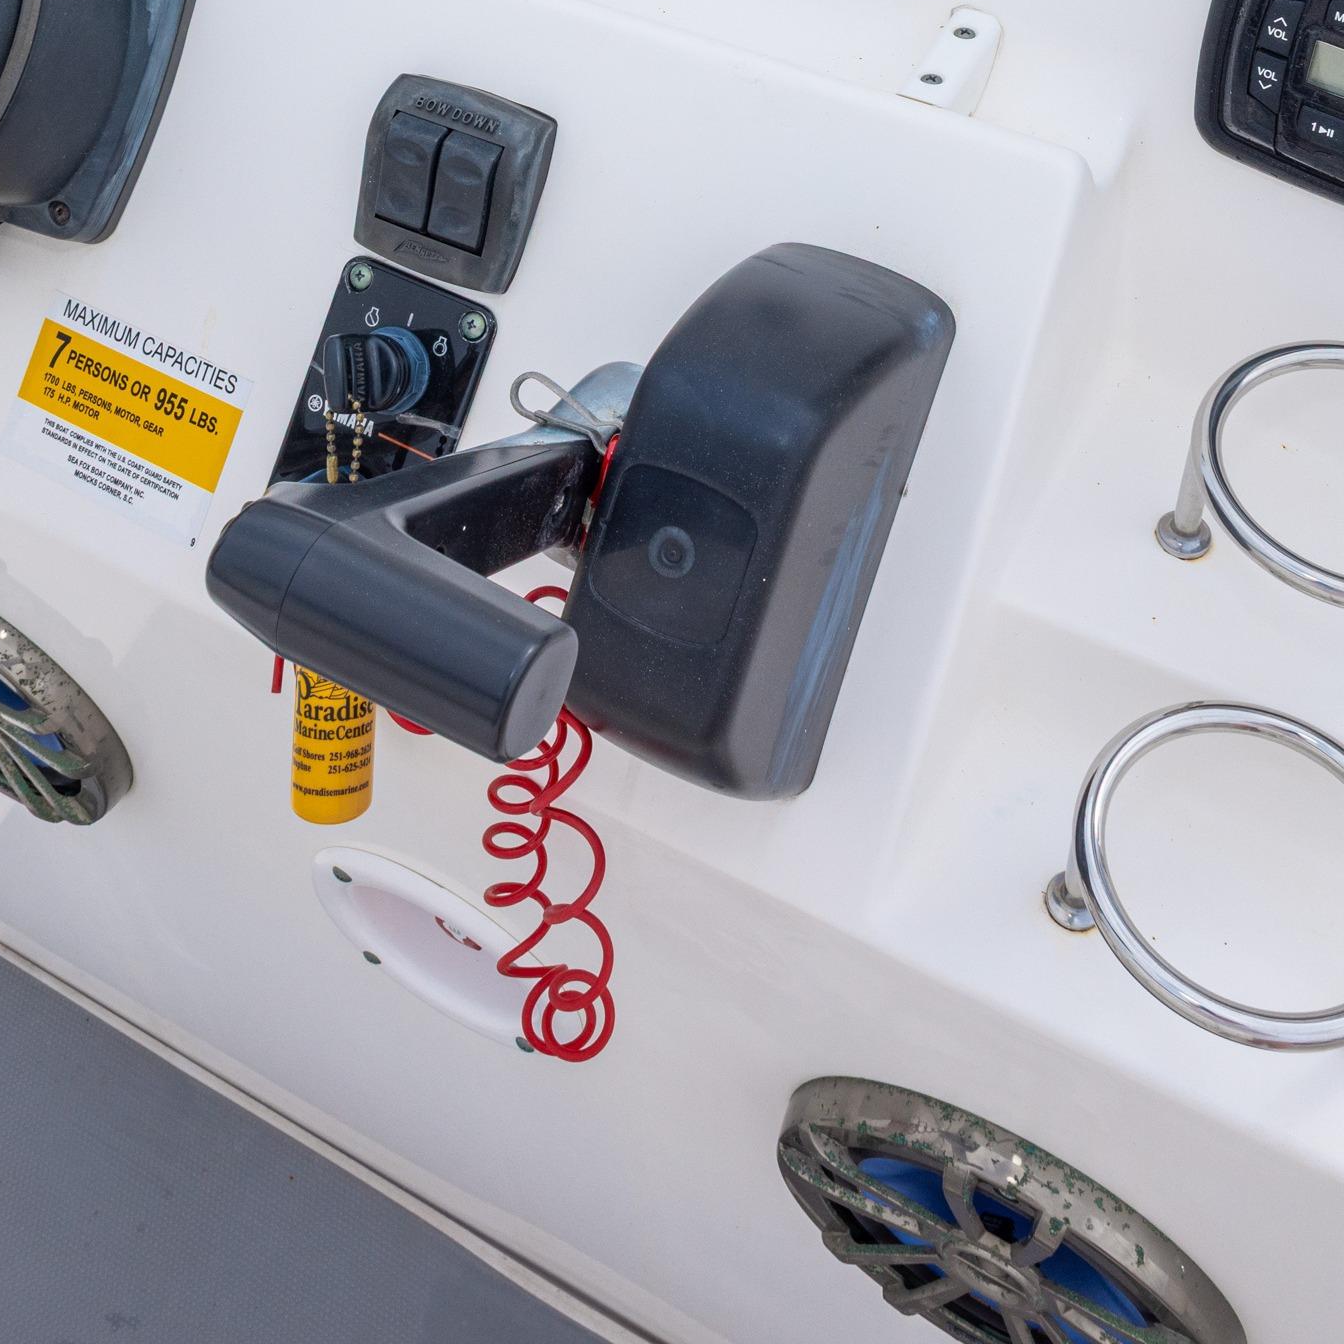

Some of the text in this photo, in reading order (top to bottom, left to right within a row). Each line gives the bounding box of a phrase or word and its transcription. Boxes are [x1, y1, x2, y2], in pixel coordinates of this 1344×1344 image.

[1267, 26, 1288, 41] VOL
[1257, 67, 1278, 81] VOL
[416, 97, 499, 133] BOW DOWN
[1311, 122, 1317, 131] 1
[62, 298, 239, 395] MAXIMUM CAPACITIES
[46, 330, 222, 435] 7 PERSONS OR 955 LBS.
[42, 385, 100, 420] 175 H.P. MOTOR
[43, 371, 60, 386] 1700
[77, 388, 114, 414] PERSONS,
[113, 405, 143, 427] MOTOR,
[141, 419, 164, 437] GEAR
[40, 426, 72, 446] STANDARDS
[77, 445, 98, 459] EFFECT
[97, 454, 106, 463] ON
[106, 459, 117, 469] THE
[116, 464, 132, 476] DATE
[131, 471, 140, 481] OF
[138, 475, 180, 500] CERTIFICATION
[55, 423, 69, 434] BOAT
[68, 430, 94, 447] COMPLIES
[106, 449, 117, 458] THE
[126, 459, 144, 472] COAST
[144, 467, 163, 481] GUARD
[162, 476, 183, 491] SAFETY
[67, 454, 145, 499] SEA FOX BOAT COMPANY, INC.
[73, 469, 98, 486] MONCKS
[97, 480, 123, 499] CORNER,
[296, 721, 373, 740] Marine Center
